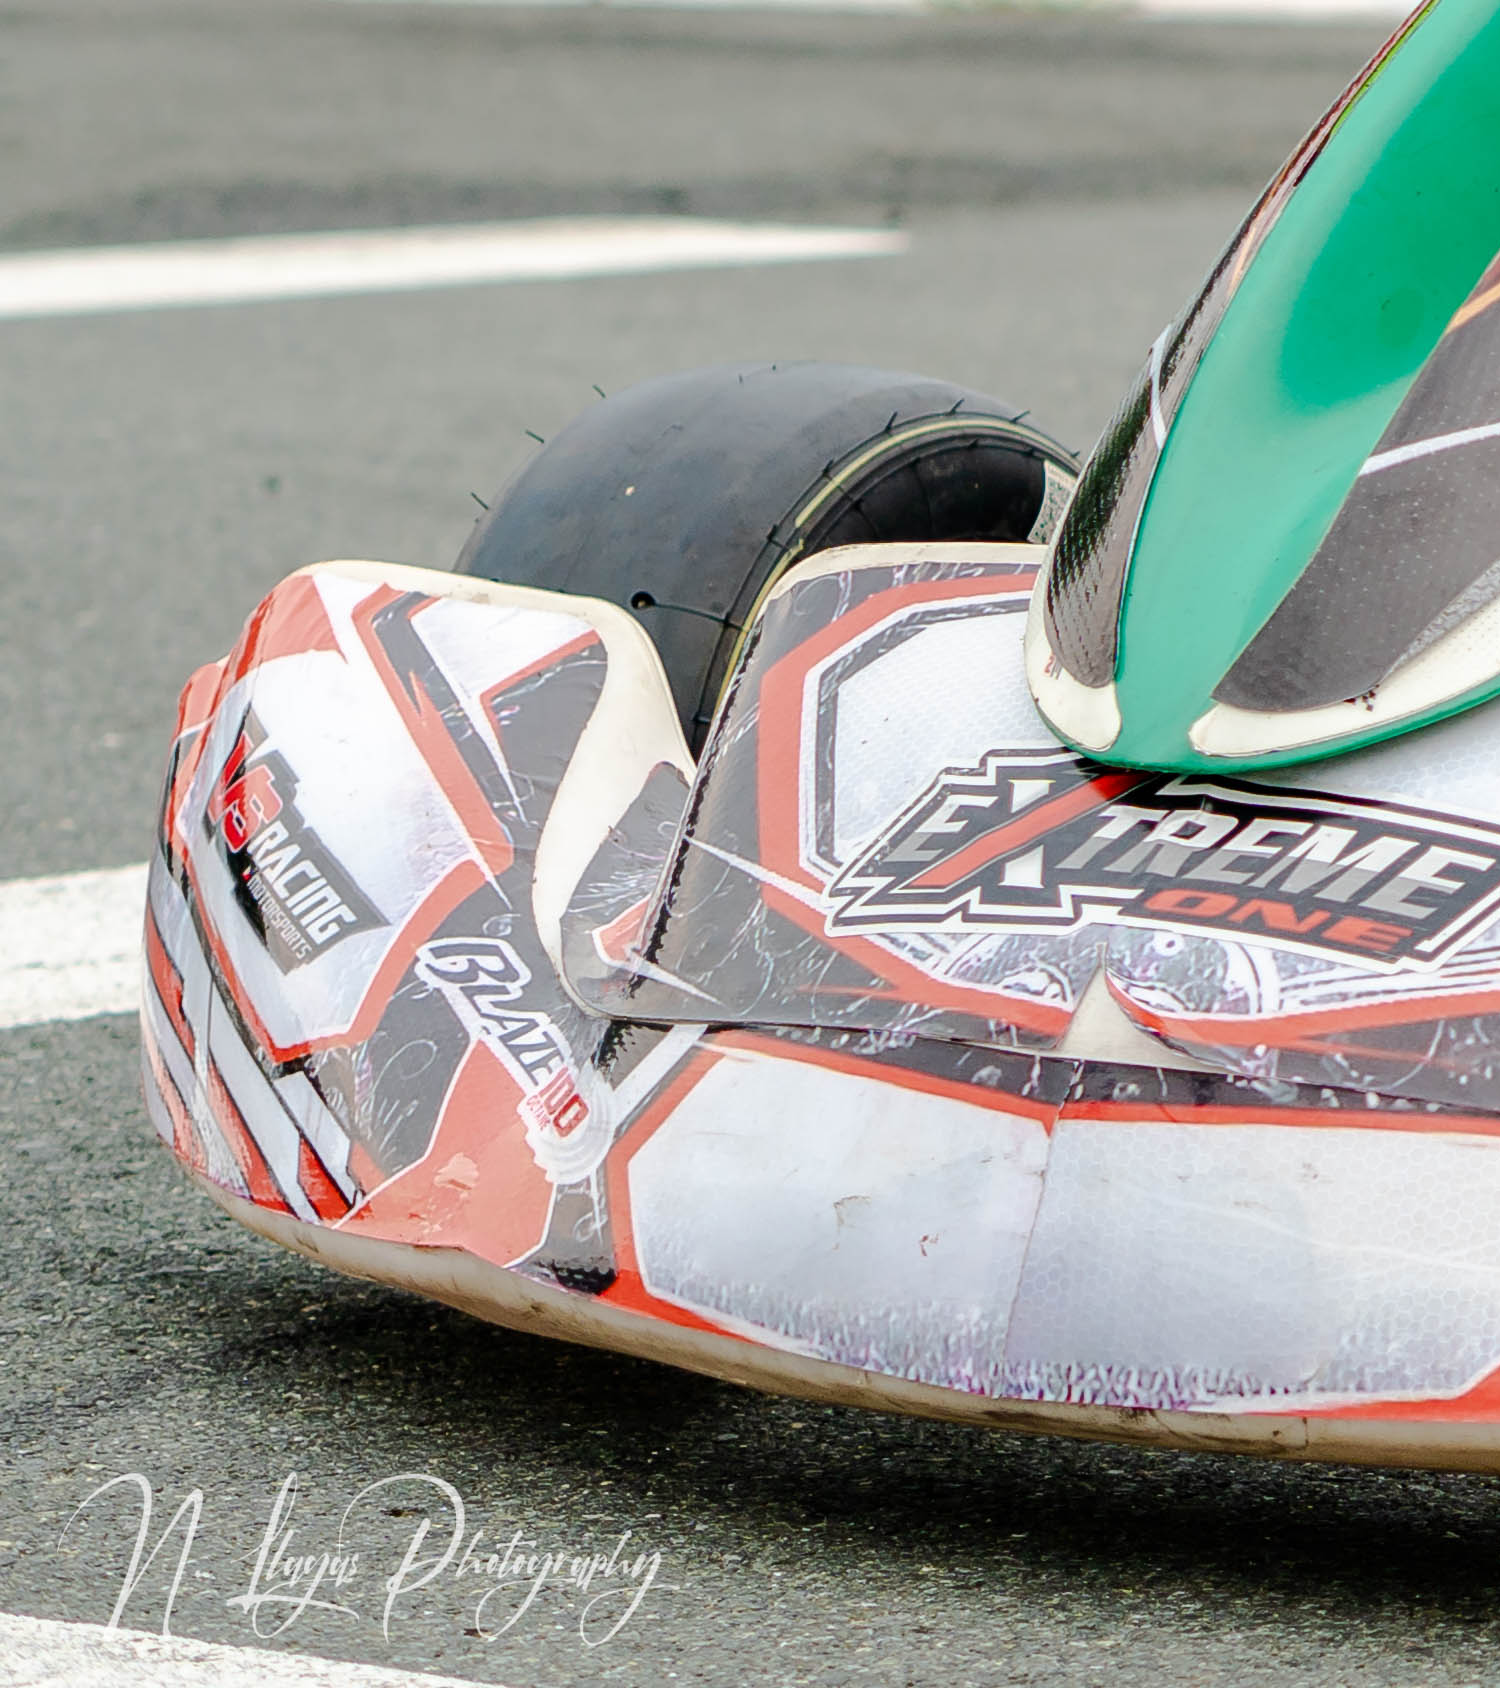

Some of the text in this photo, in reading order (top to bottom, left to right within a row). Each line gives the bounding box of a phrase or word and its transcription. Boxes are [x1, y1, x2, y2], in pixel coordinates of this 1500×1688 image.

[246, 820, 358, 946] RACING
[885, 770, 1497, 921] EXTREME
[246, 875, 313, 962] MOTORSPORTS
[1143, 889, 1415, 952] ONE
